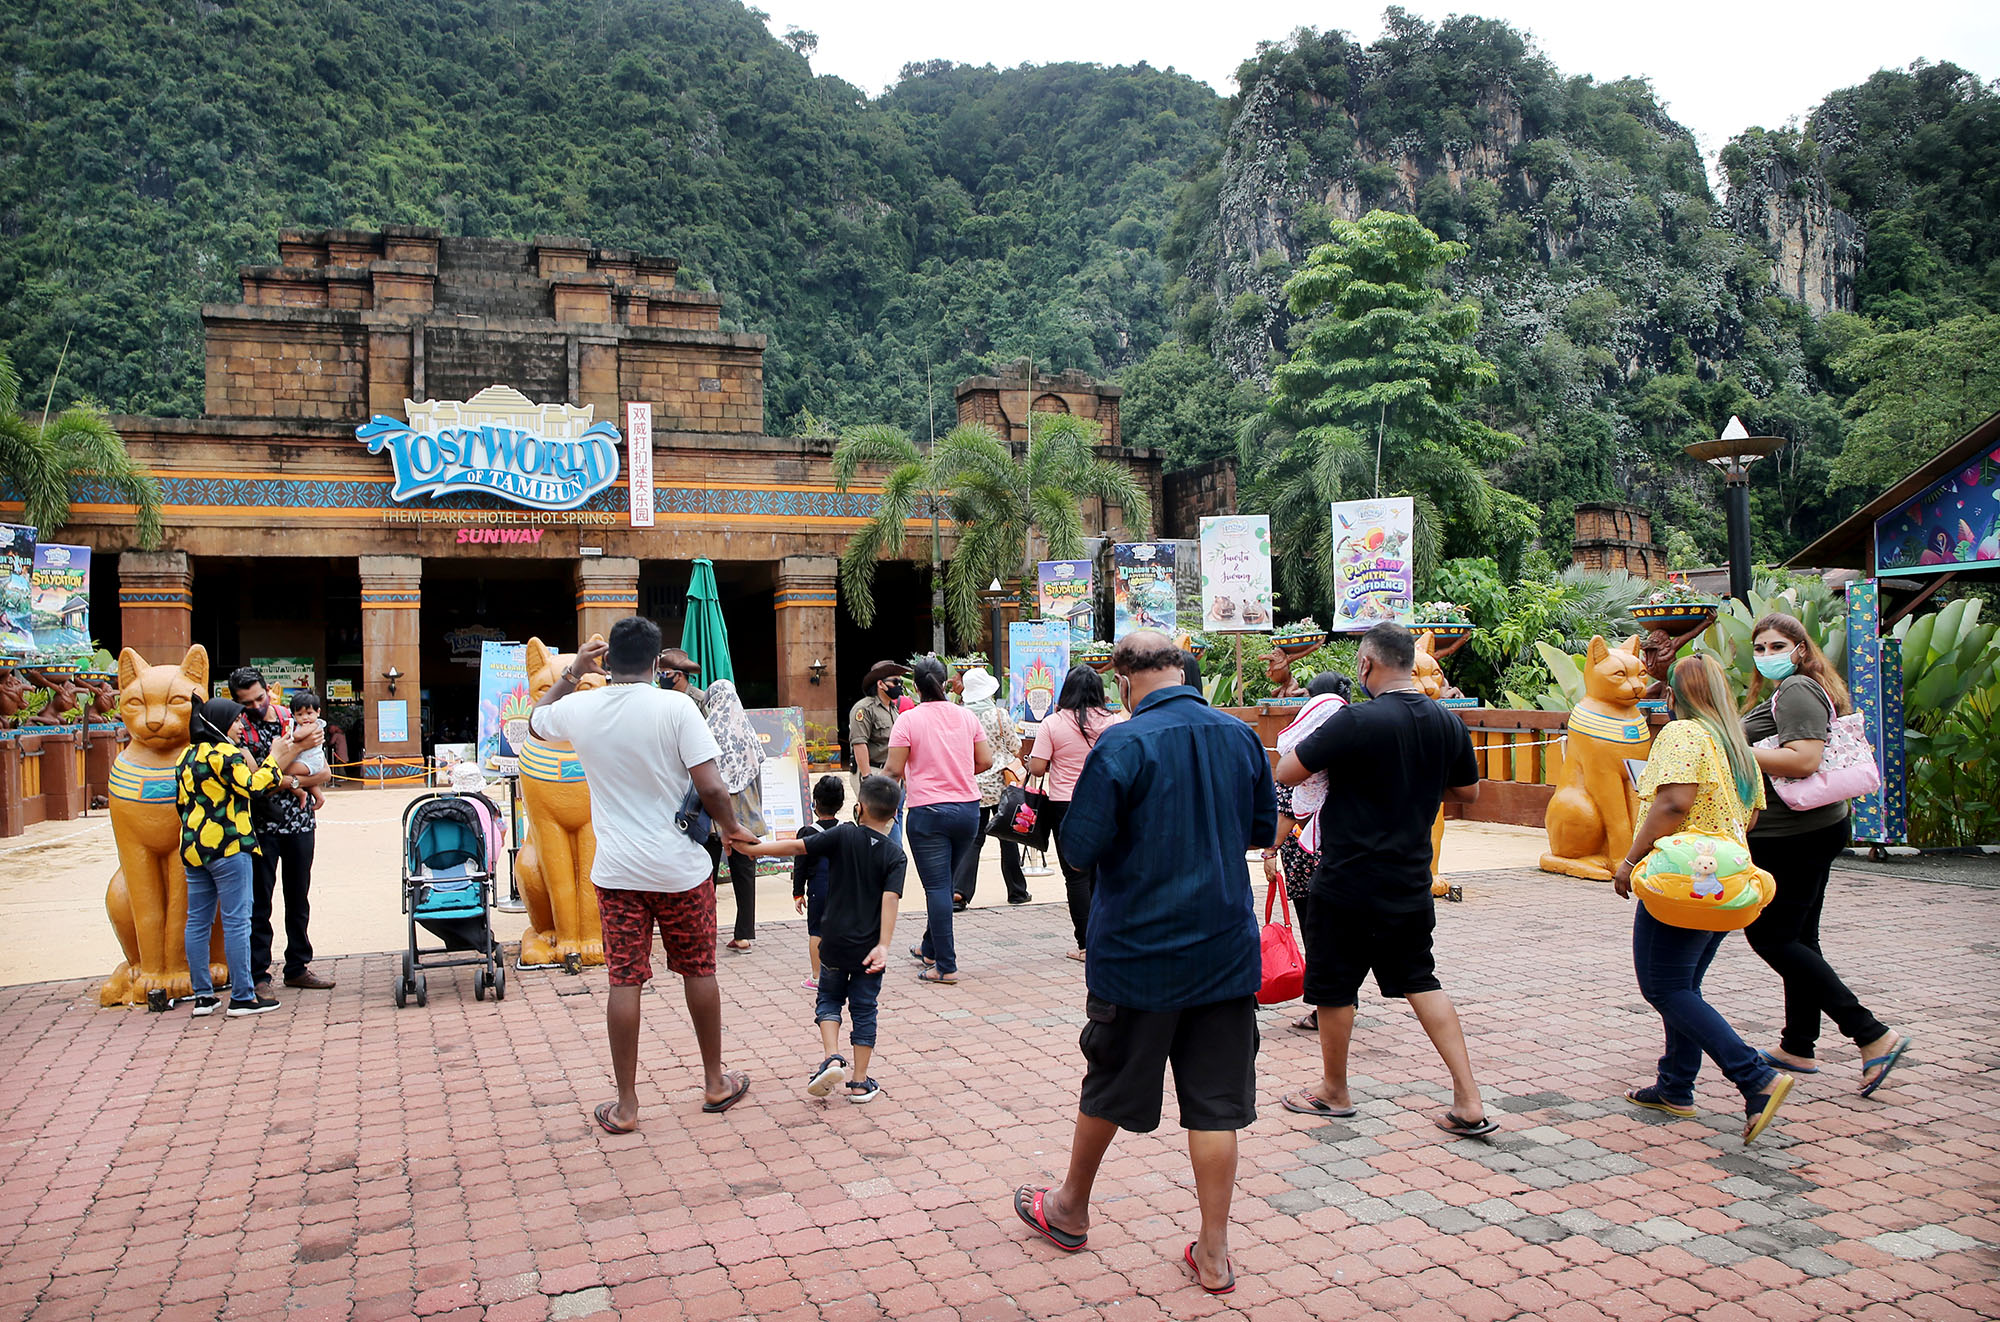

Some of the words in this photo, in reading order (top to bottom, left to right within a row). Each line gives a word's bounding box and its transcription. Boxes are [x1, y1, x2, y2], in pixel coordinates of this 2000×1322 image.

[388, 428, 483, 497] LOST
[480, 426, 614, 489] WORLD
[633, 407, 649, 522] 双威打扪迷失乐园
[467, 470, 483, 483] OF
[489, 470, 583, 501] TAMBUN
[381, 510, 430, 523] THEME
[432, 511, 466, 523] PARK
[477, 511, 520, 524] HOTEL
[531, 511, 561, 524] HOT
[562, 512, 616, 525] SPRINGS
[456, 528, 545, 544] SUNWAY
[1343, 560, 1371, 580] PLAY
[1376, 557, 1405, 572] STAY
[32, 572, 82, 587] STAYCATION
[1361, 571, 1385, 583] WITH
[1045, 585, 1087, 595] STAYCATION
[1347, 581, 1405, 599] CONFIDENCE
[215, 686, 222, 698] 6
[328, 685, 335, 697] 5
